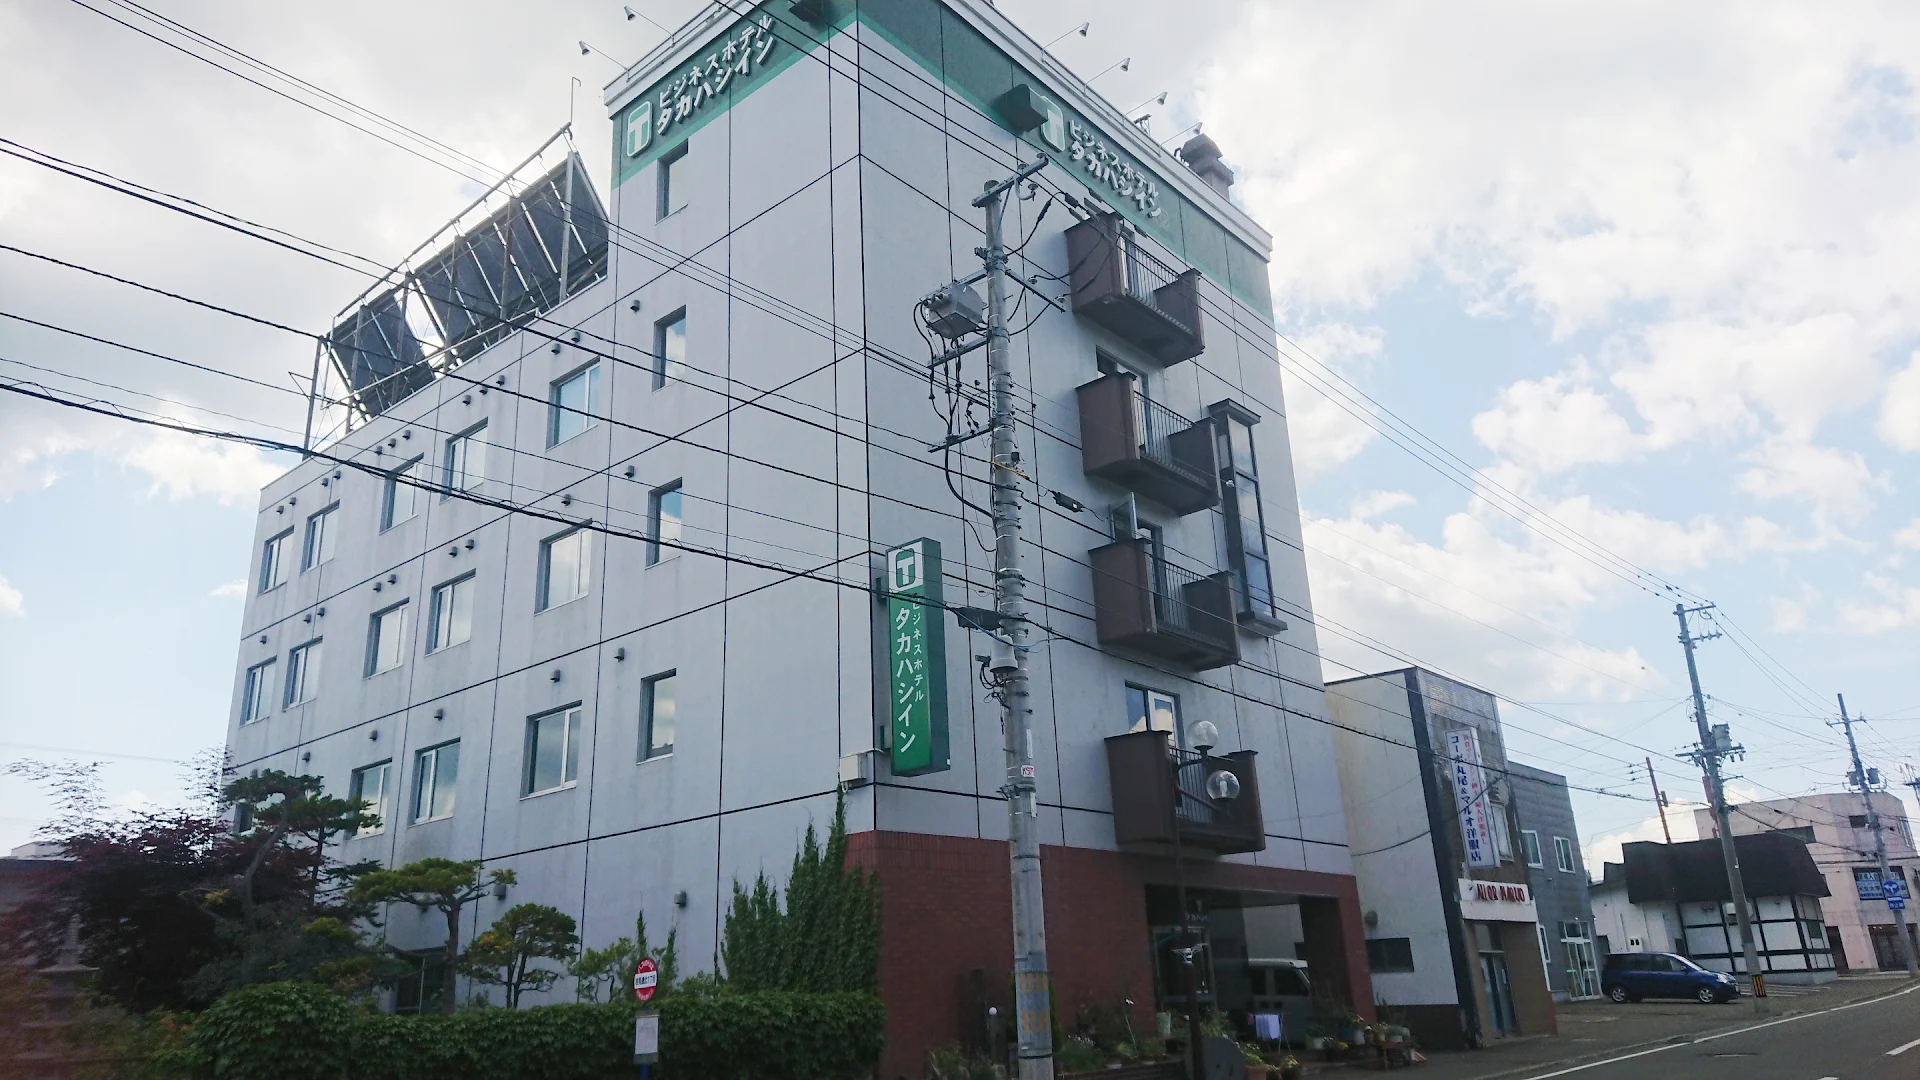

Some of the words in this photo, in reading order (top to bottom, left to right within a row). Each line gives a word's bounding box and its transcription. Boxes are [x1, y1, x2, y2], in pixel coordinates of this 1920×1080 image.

[657, 36, 774, 135] タカハシイン
[659, 15, 773, 108] ビジネスホテル
[1069, 119, 1160, 199] ビジネスホテル
[1070, 140, 1162, 218] タカハシイン
[895, 607, 916, 754] タカハシイン
[911, 597, 925, 703] ビジネスホテル
